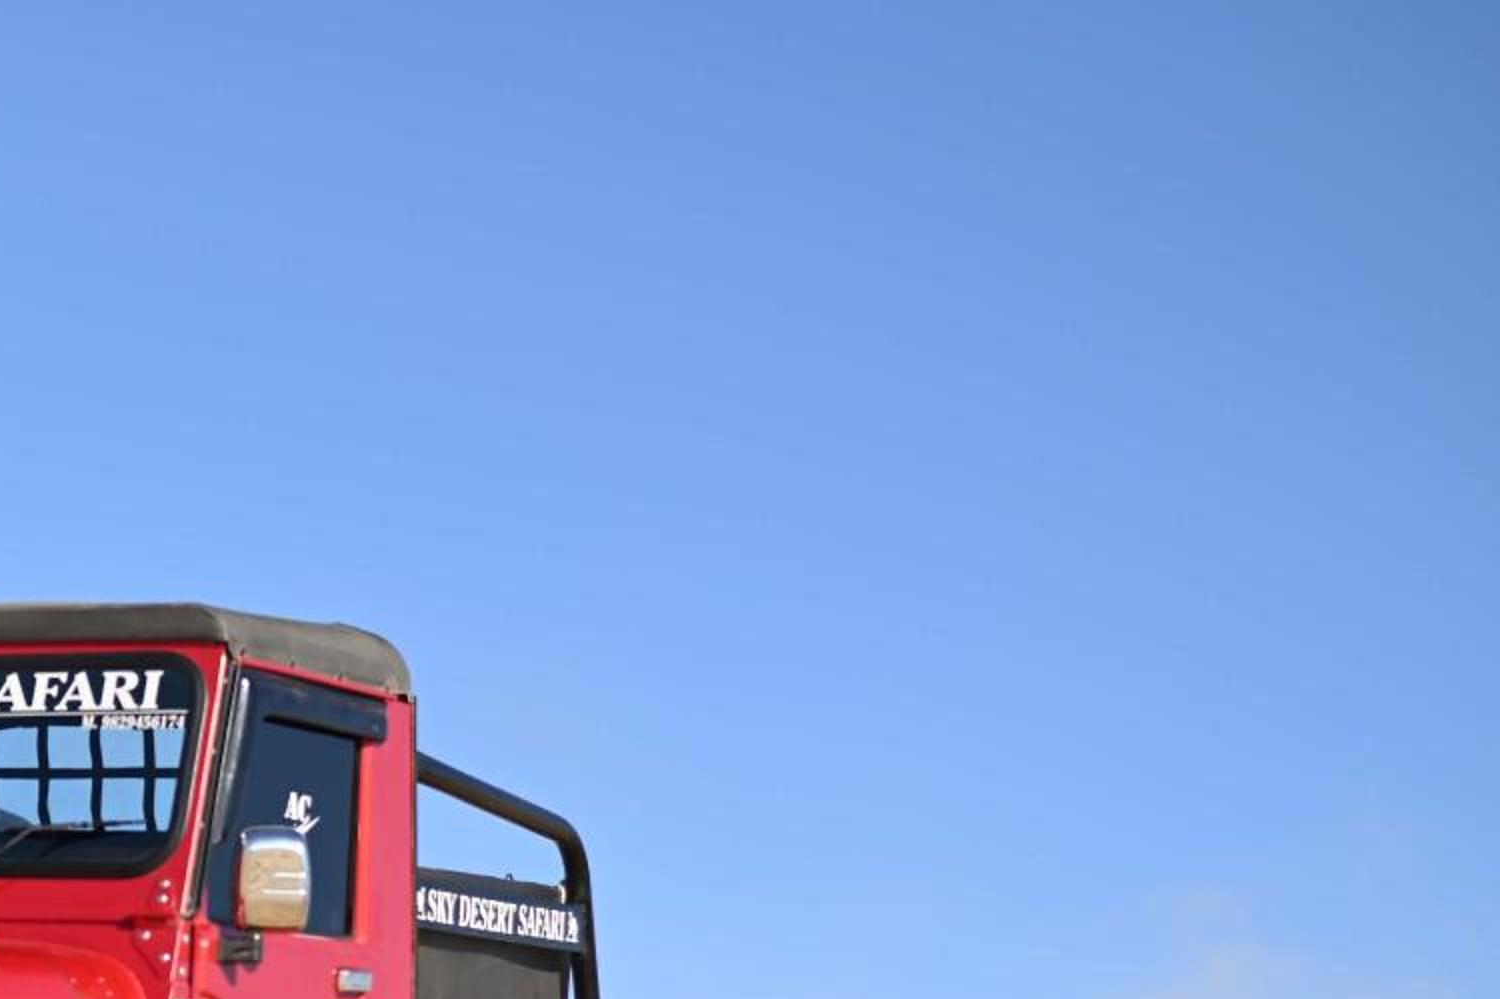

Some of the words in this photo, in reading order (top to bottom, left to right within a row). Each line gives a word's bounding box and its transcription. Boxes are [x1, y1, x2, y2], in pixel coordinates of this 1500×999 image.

[283, 791, 313, 825] AC
[427, 887, 460, 925] SKY
[458, 893, 518, 936] DESERT
[516, 903, 566, 942] SAFARI
